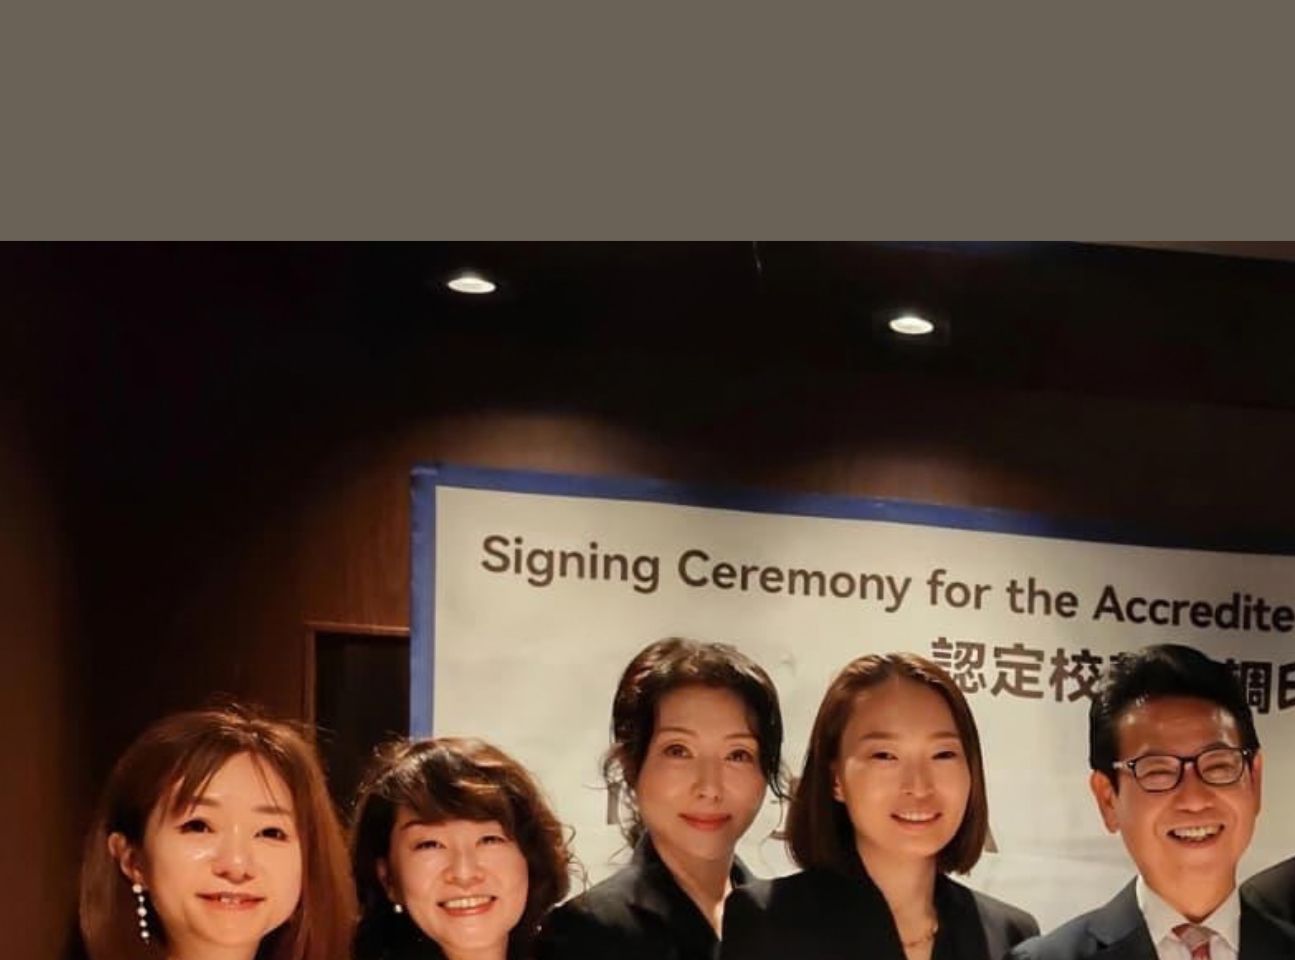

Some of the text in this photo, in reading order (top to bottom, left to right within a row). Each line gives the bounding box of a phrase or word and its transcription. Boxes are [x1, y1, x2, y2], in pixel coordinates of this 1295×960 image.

[481, 535, 660, 594] Signing
[678, 549, 912, 613] Ceremony
[927, 569, 991, 606] for
[1006, 577, 1079, 618] the
